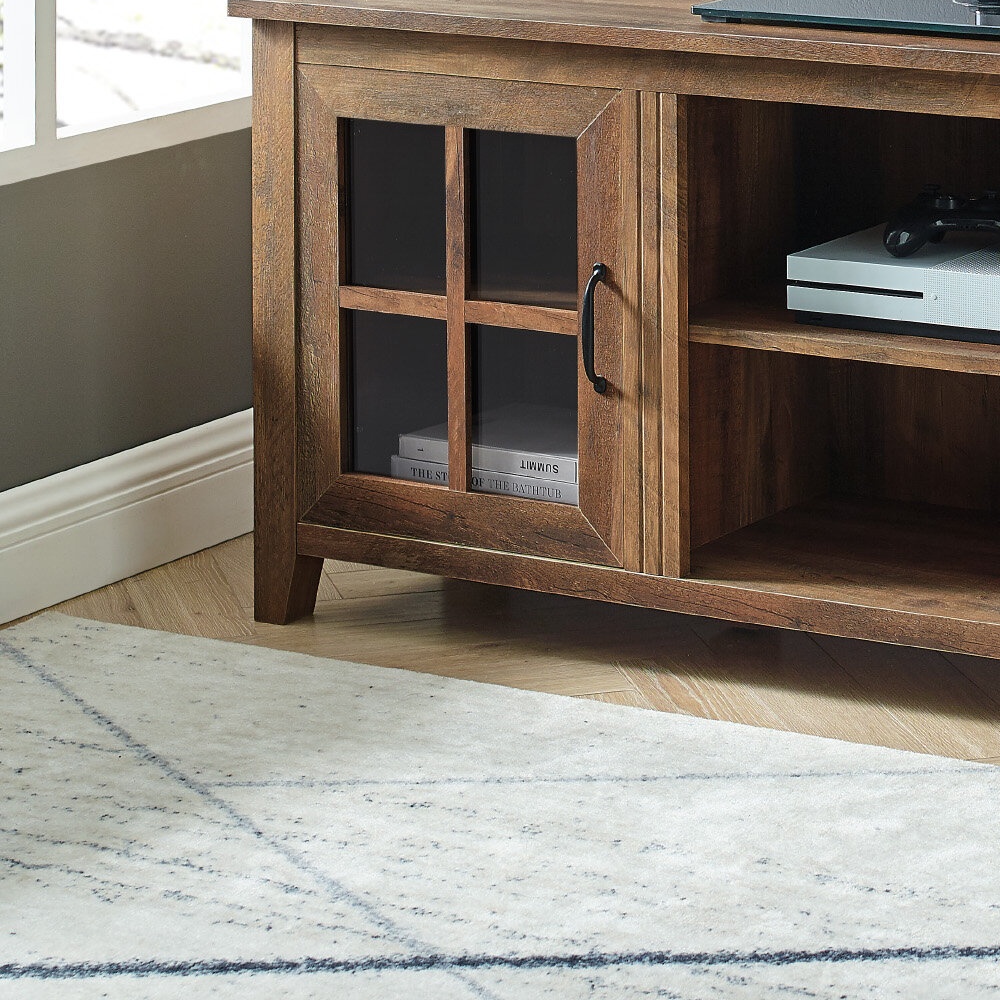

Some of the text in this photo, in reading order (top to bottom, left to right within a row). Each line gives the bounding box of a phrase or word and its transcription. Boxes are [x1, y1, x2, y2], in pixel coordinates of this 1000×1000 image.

[519, 460, 559, 474] SUMMIT
[410, 467, 432, 479] THE
[472, 476, 485, 487] OF
[487, 479, 510, 491] THE
[512, 482, 562, 499] BATHTUB
